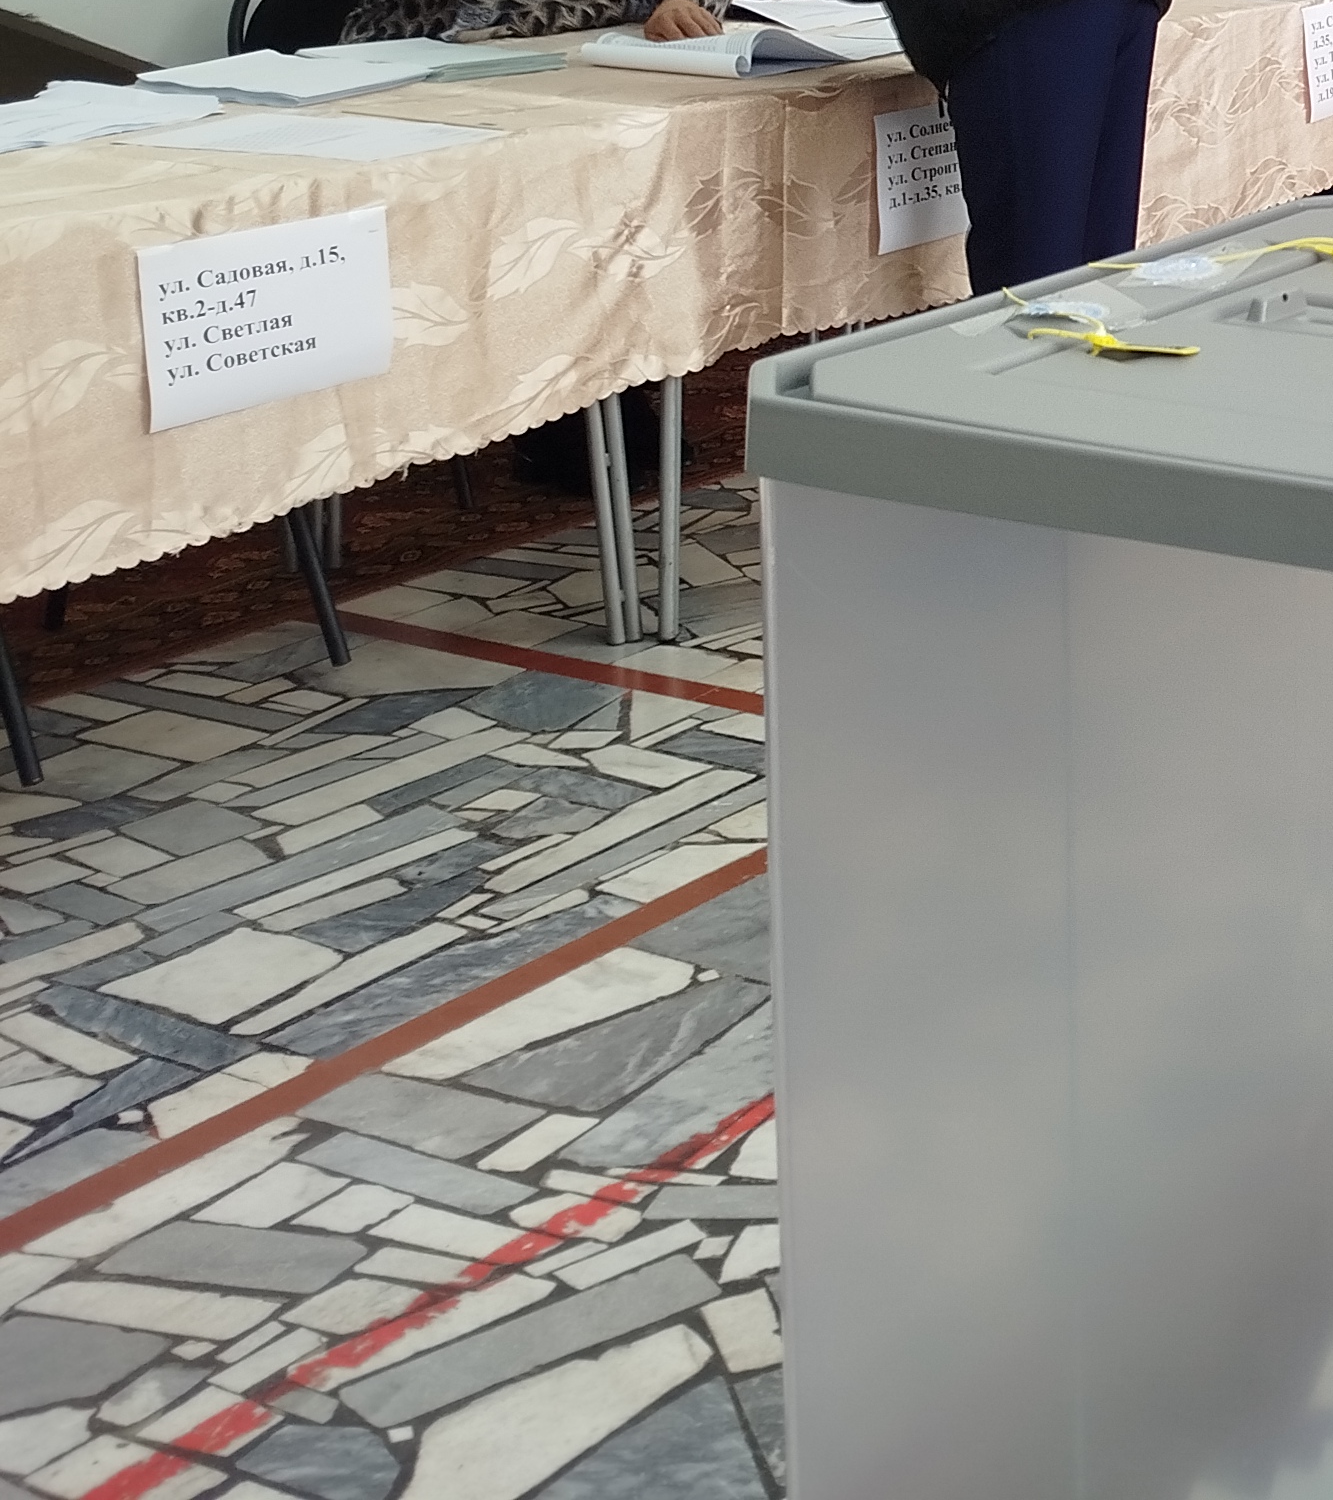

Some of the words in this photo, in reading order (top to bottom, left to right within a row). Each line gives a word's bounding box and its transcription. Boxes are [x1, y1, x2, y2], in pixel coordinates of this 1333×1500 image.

[1310, 21, 1325, 34] ул.
[1313, 56, 1328, 70] ул.
[1315, 74, 1330, 88] ул.
[886, 132, 907, 148] ул.
[887, 154, 907, 169] ул.
[887, 176, 908, 191] ул.
[158, 279, 190, 301] ул.
[197, 260, 294, 287] Садовая,
[300, 245, 346, 271] д.15,
[161, 289, 257, 325] кв.2-д.47
[164, 336, 197, 358] ул.
[203, 314, 293, 344] Светлая
[167, 365, 200, 386] ул.
[206, 336, 317, 372] Советская
